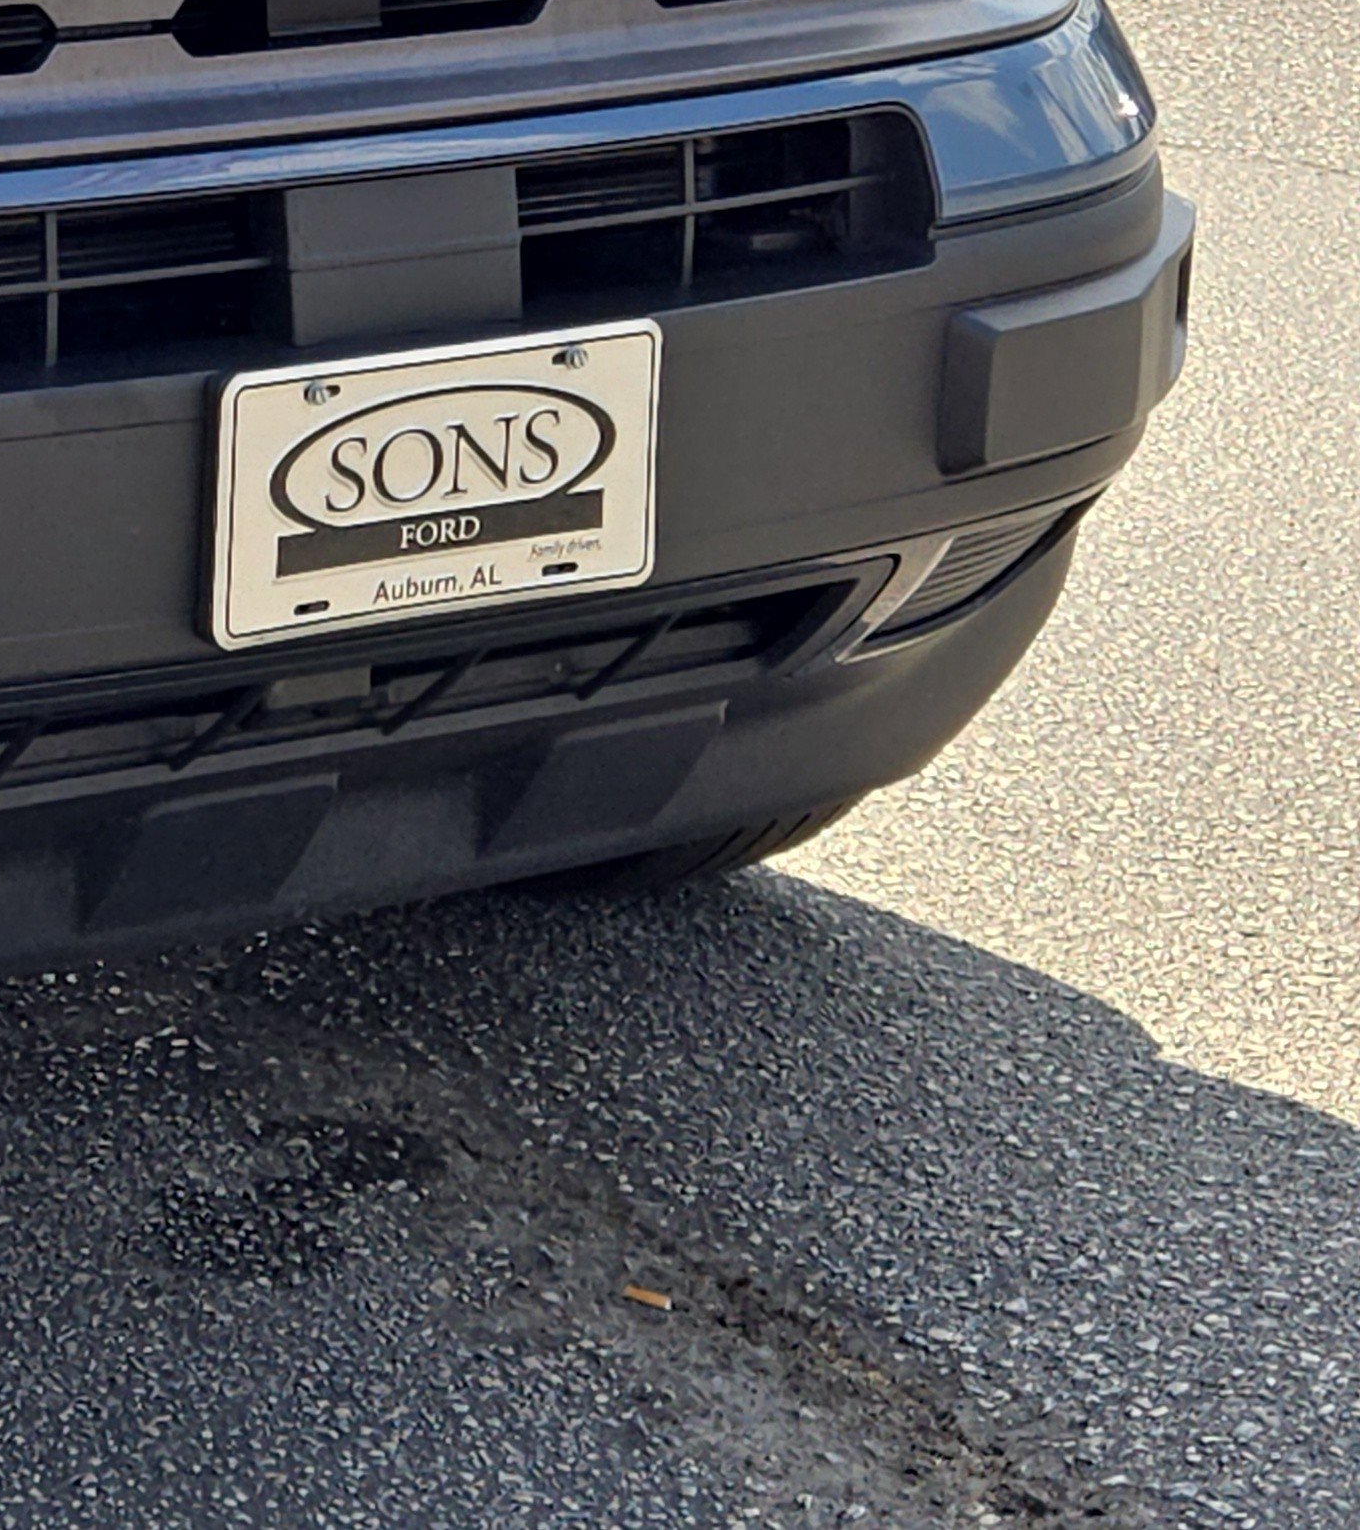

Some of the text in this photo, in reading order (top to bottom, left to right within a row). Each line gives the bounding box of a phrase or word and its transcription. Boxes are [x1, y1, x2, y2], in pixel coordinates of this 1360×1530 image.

[324, 408, 562, 513] SONS
[399, 515, 481, 549] FORD
[372, 564, 503, 604] Auburn, AL
